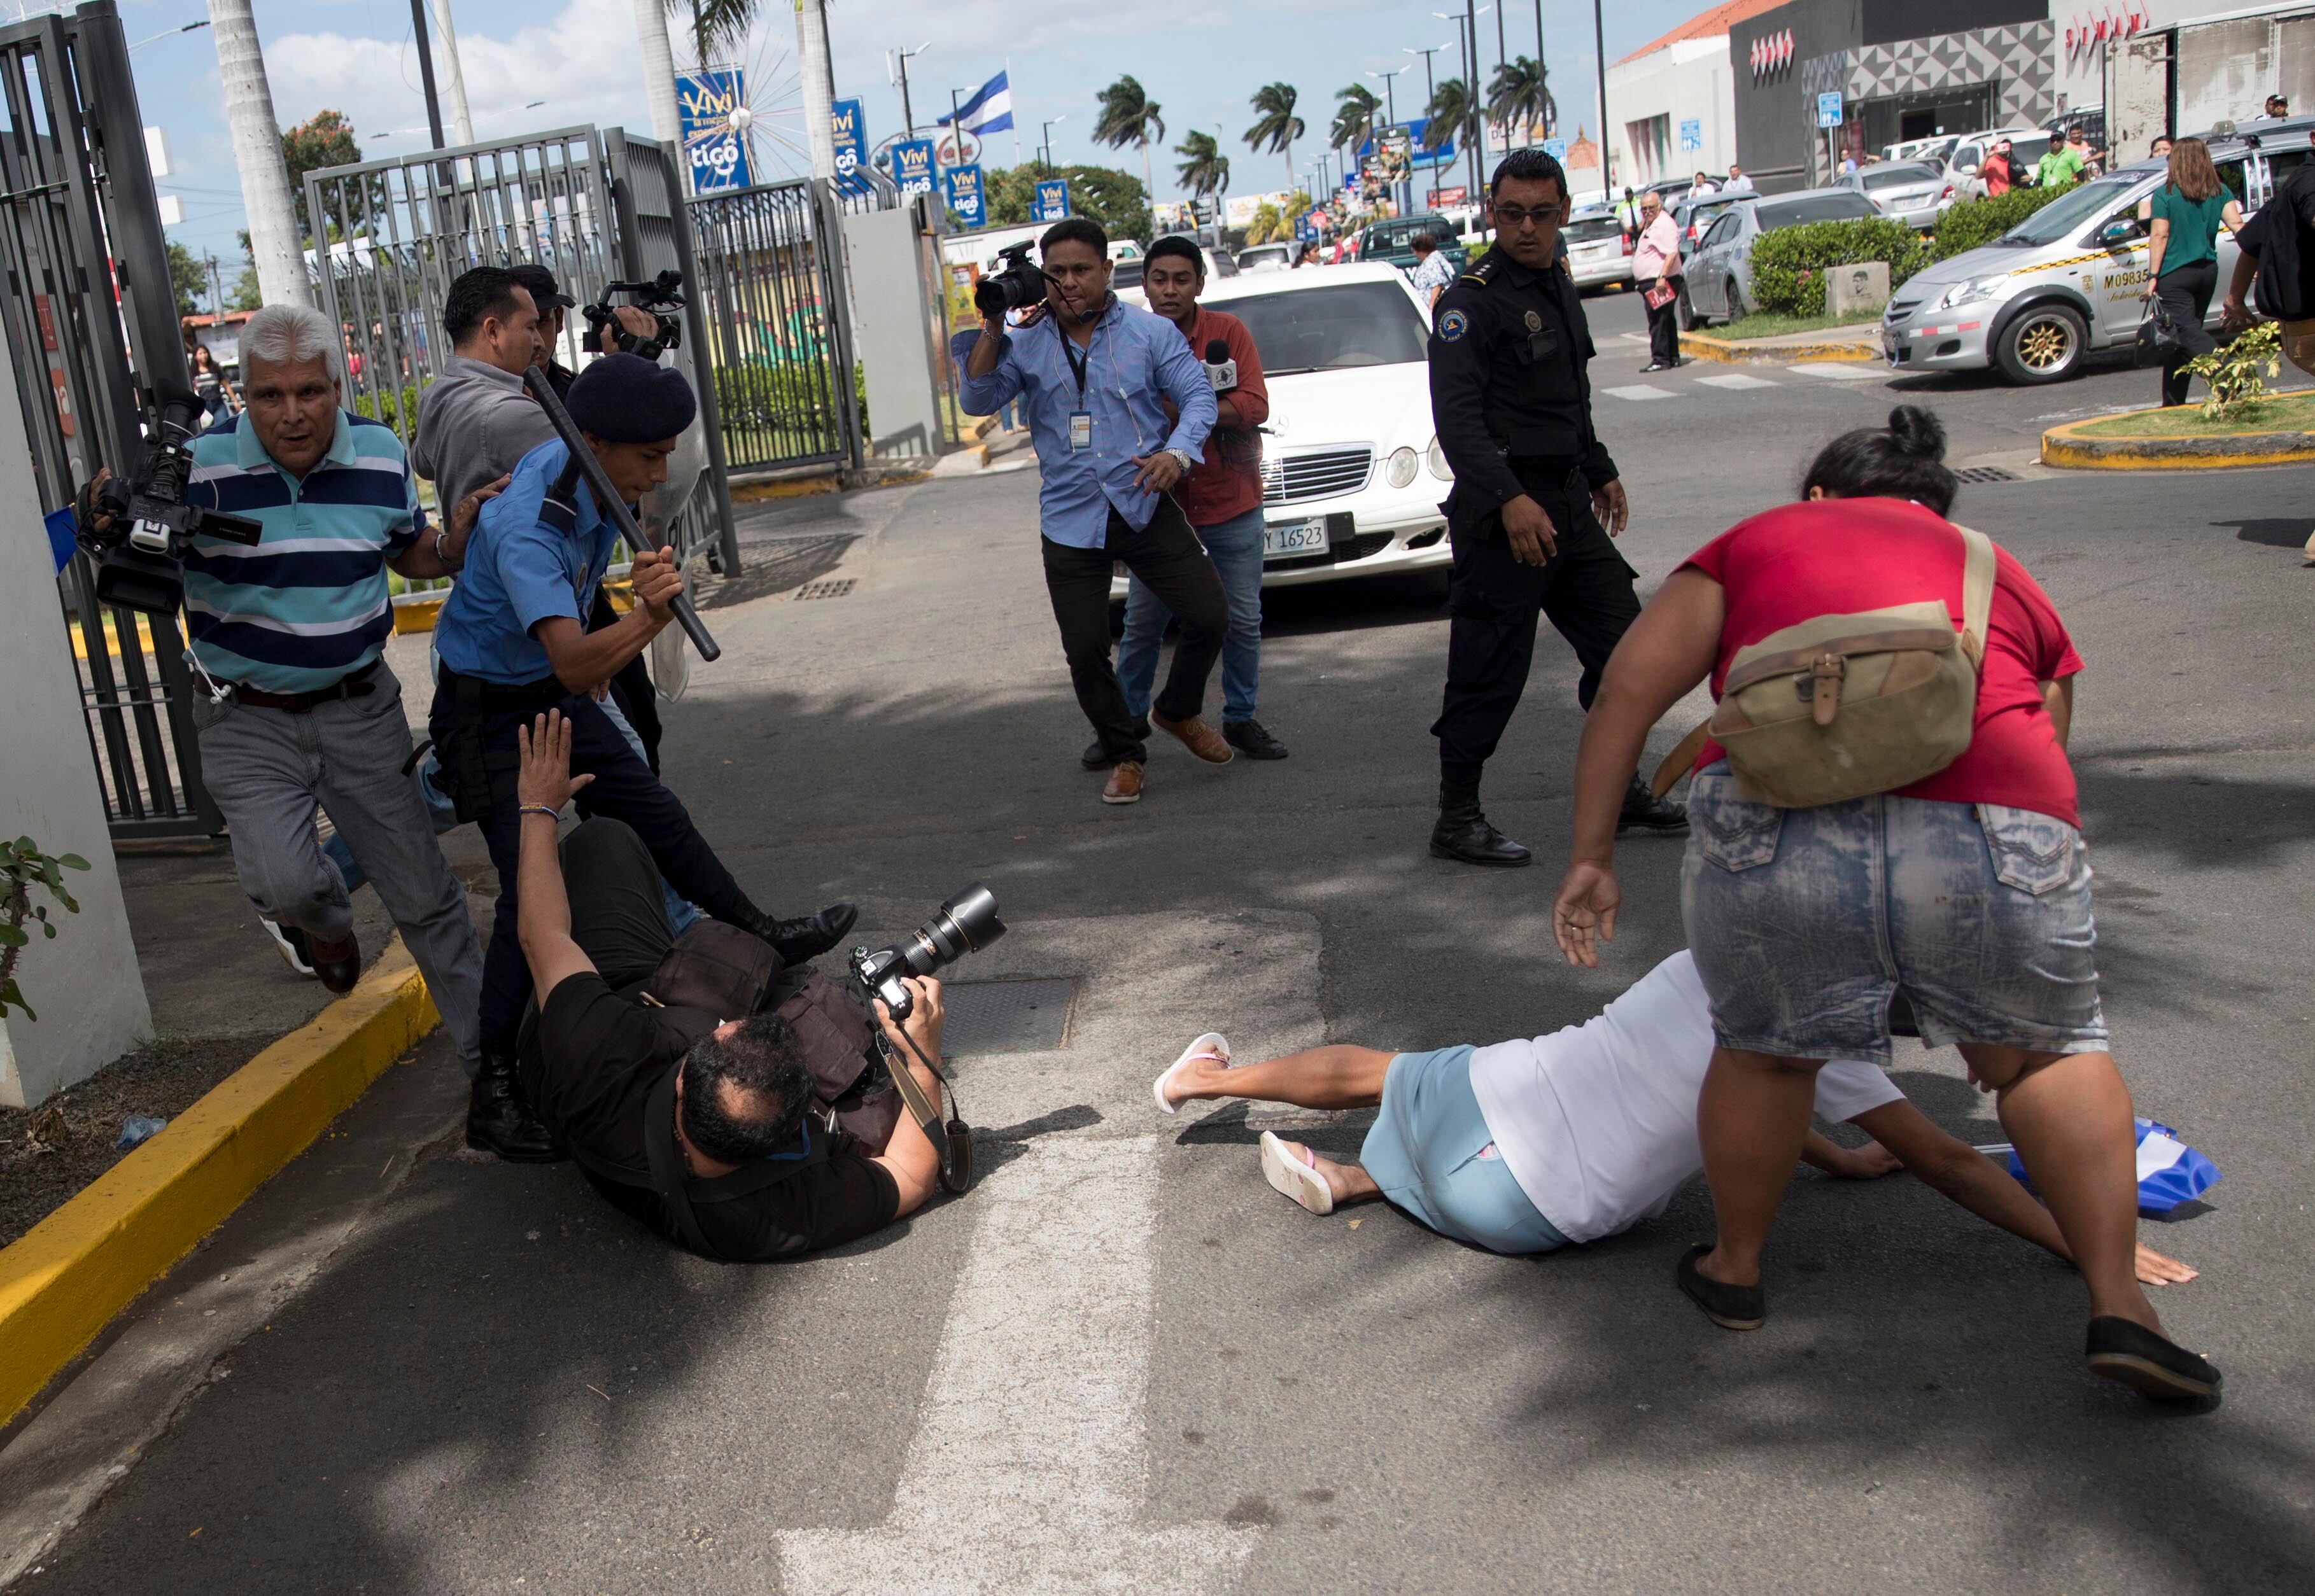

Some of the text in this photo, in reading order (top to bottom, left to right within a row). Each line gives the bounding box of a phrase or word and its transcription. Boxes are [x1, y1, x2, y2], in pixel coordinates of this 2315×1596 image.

[832, 108, 854, 132] iví
[835, 148, 857, 177] go
[2104, 269, 2149, 290] M09835
[1027, 307, 1046, 325] Canon
[1279, 526, 1322, 548] 16523
